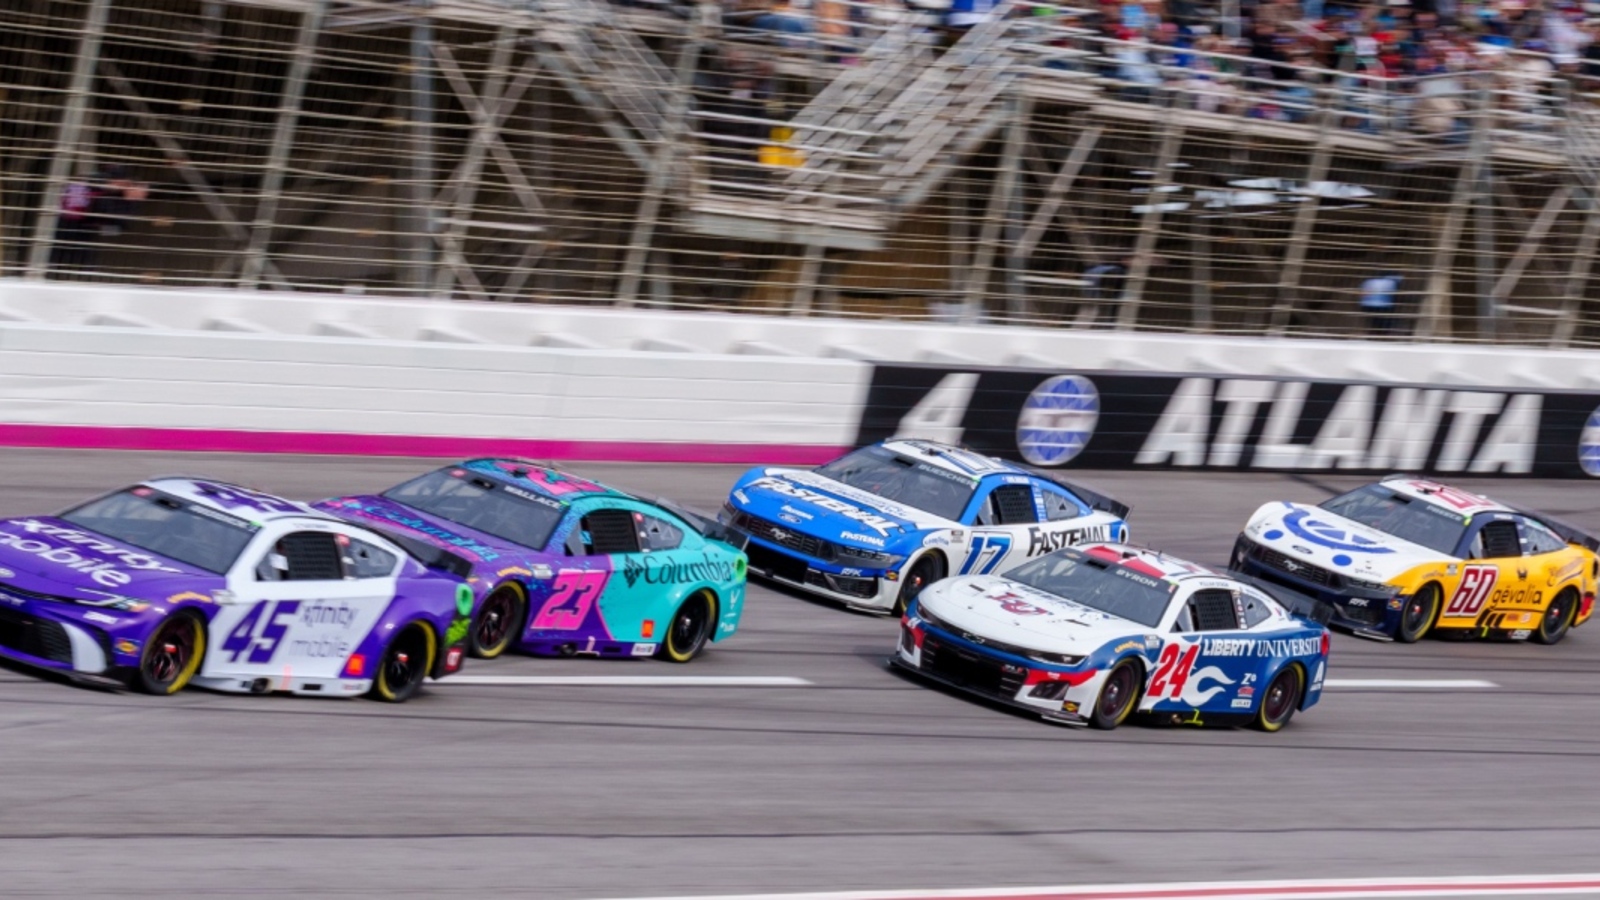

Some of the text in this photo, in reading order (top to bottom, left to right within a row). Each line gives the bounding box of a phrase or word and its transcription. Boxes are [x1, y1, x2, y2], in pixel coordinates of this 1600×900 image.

[1133, 376, 1544, 474] ATLANTA
[503, 485, 562, 509] WALLACE
[918, 464, 977, 489] BUESCHER
[744, 477, 901, 537] FASTENAL
[8, 519, 184, 573] xfinity
[840, 530, 885, 547] FASTENAL
[959, 531, 1013, 575] 17
[643, 555, 732, 585] Columbia
[1116, 568, 1158, 588] BYRON
[1444, 565, 1498, 617] 60
[300, 598, 360, 629] xfinity
[530, 568, 607, 630] 23
[221, 599, 302, 664] 45
[1202, 638, 1255, 657] LIBERTY
[1147, 643, 1201, 700] 24
